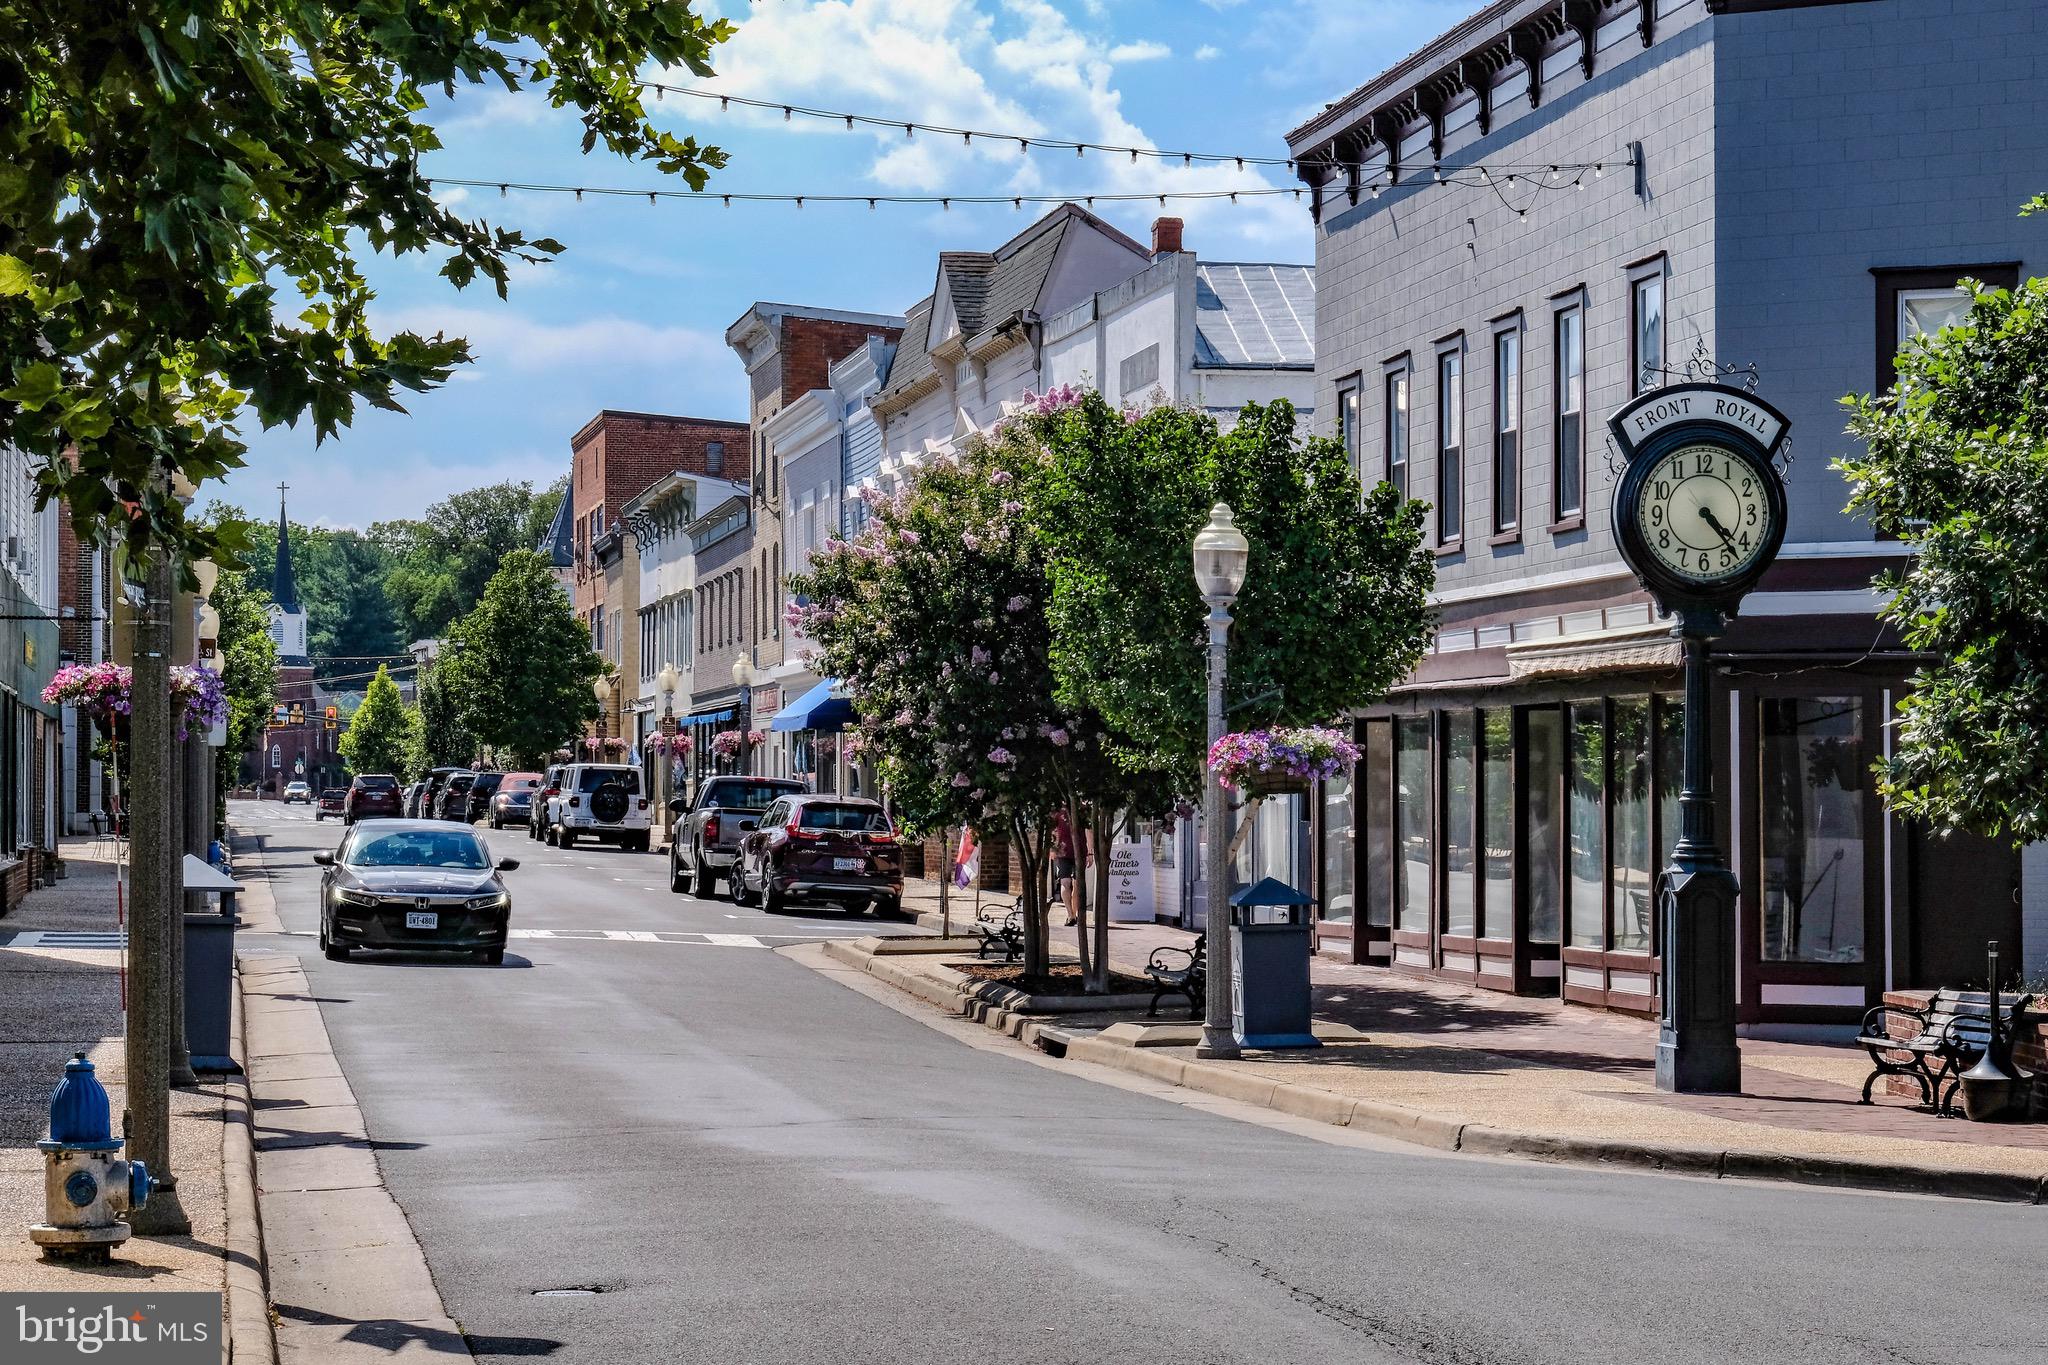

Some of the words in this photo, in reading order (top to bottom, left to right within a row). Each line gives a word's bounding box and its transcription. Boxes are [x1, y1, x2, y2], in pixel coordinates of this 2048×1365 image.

[1635, 398, 1691, 432] FRONT
[1715, 399, 1768, 434] ROYAL
[1671, 460, 1684, 479] 11
[1696, 454, 1713, 474] 12
[1725, 460, 1731, 480] 1
[1654, 480, 1670, 500] 10
[1742, 477, 1753, 497] 2
[1652, 505, 1663, 527] 9
[1746, 503, 1757, 526] 3
[1659, 528, 1670, 549] 8
[1738, 531, 1750, 551] 4
[1675, 547, 1689, 567] 7
[1698, 552, 1710, 571] 6
[1720, 548, 1731, 567] 5
[1110, 859, 1140, 868] Timers
[1116, 851, 1132, 859] Ole
[1121, 878, 1130, 887] &
